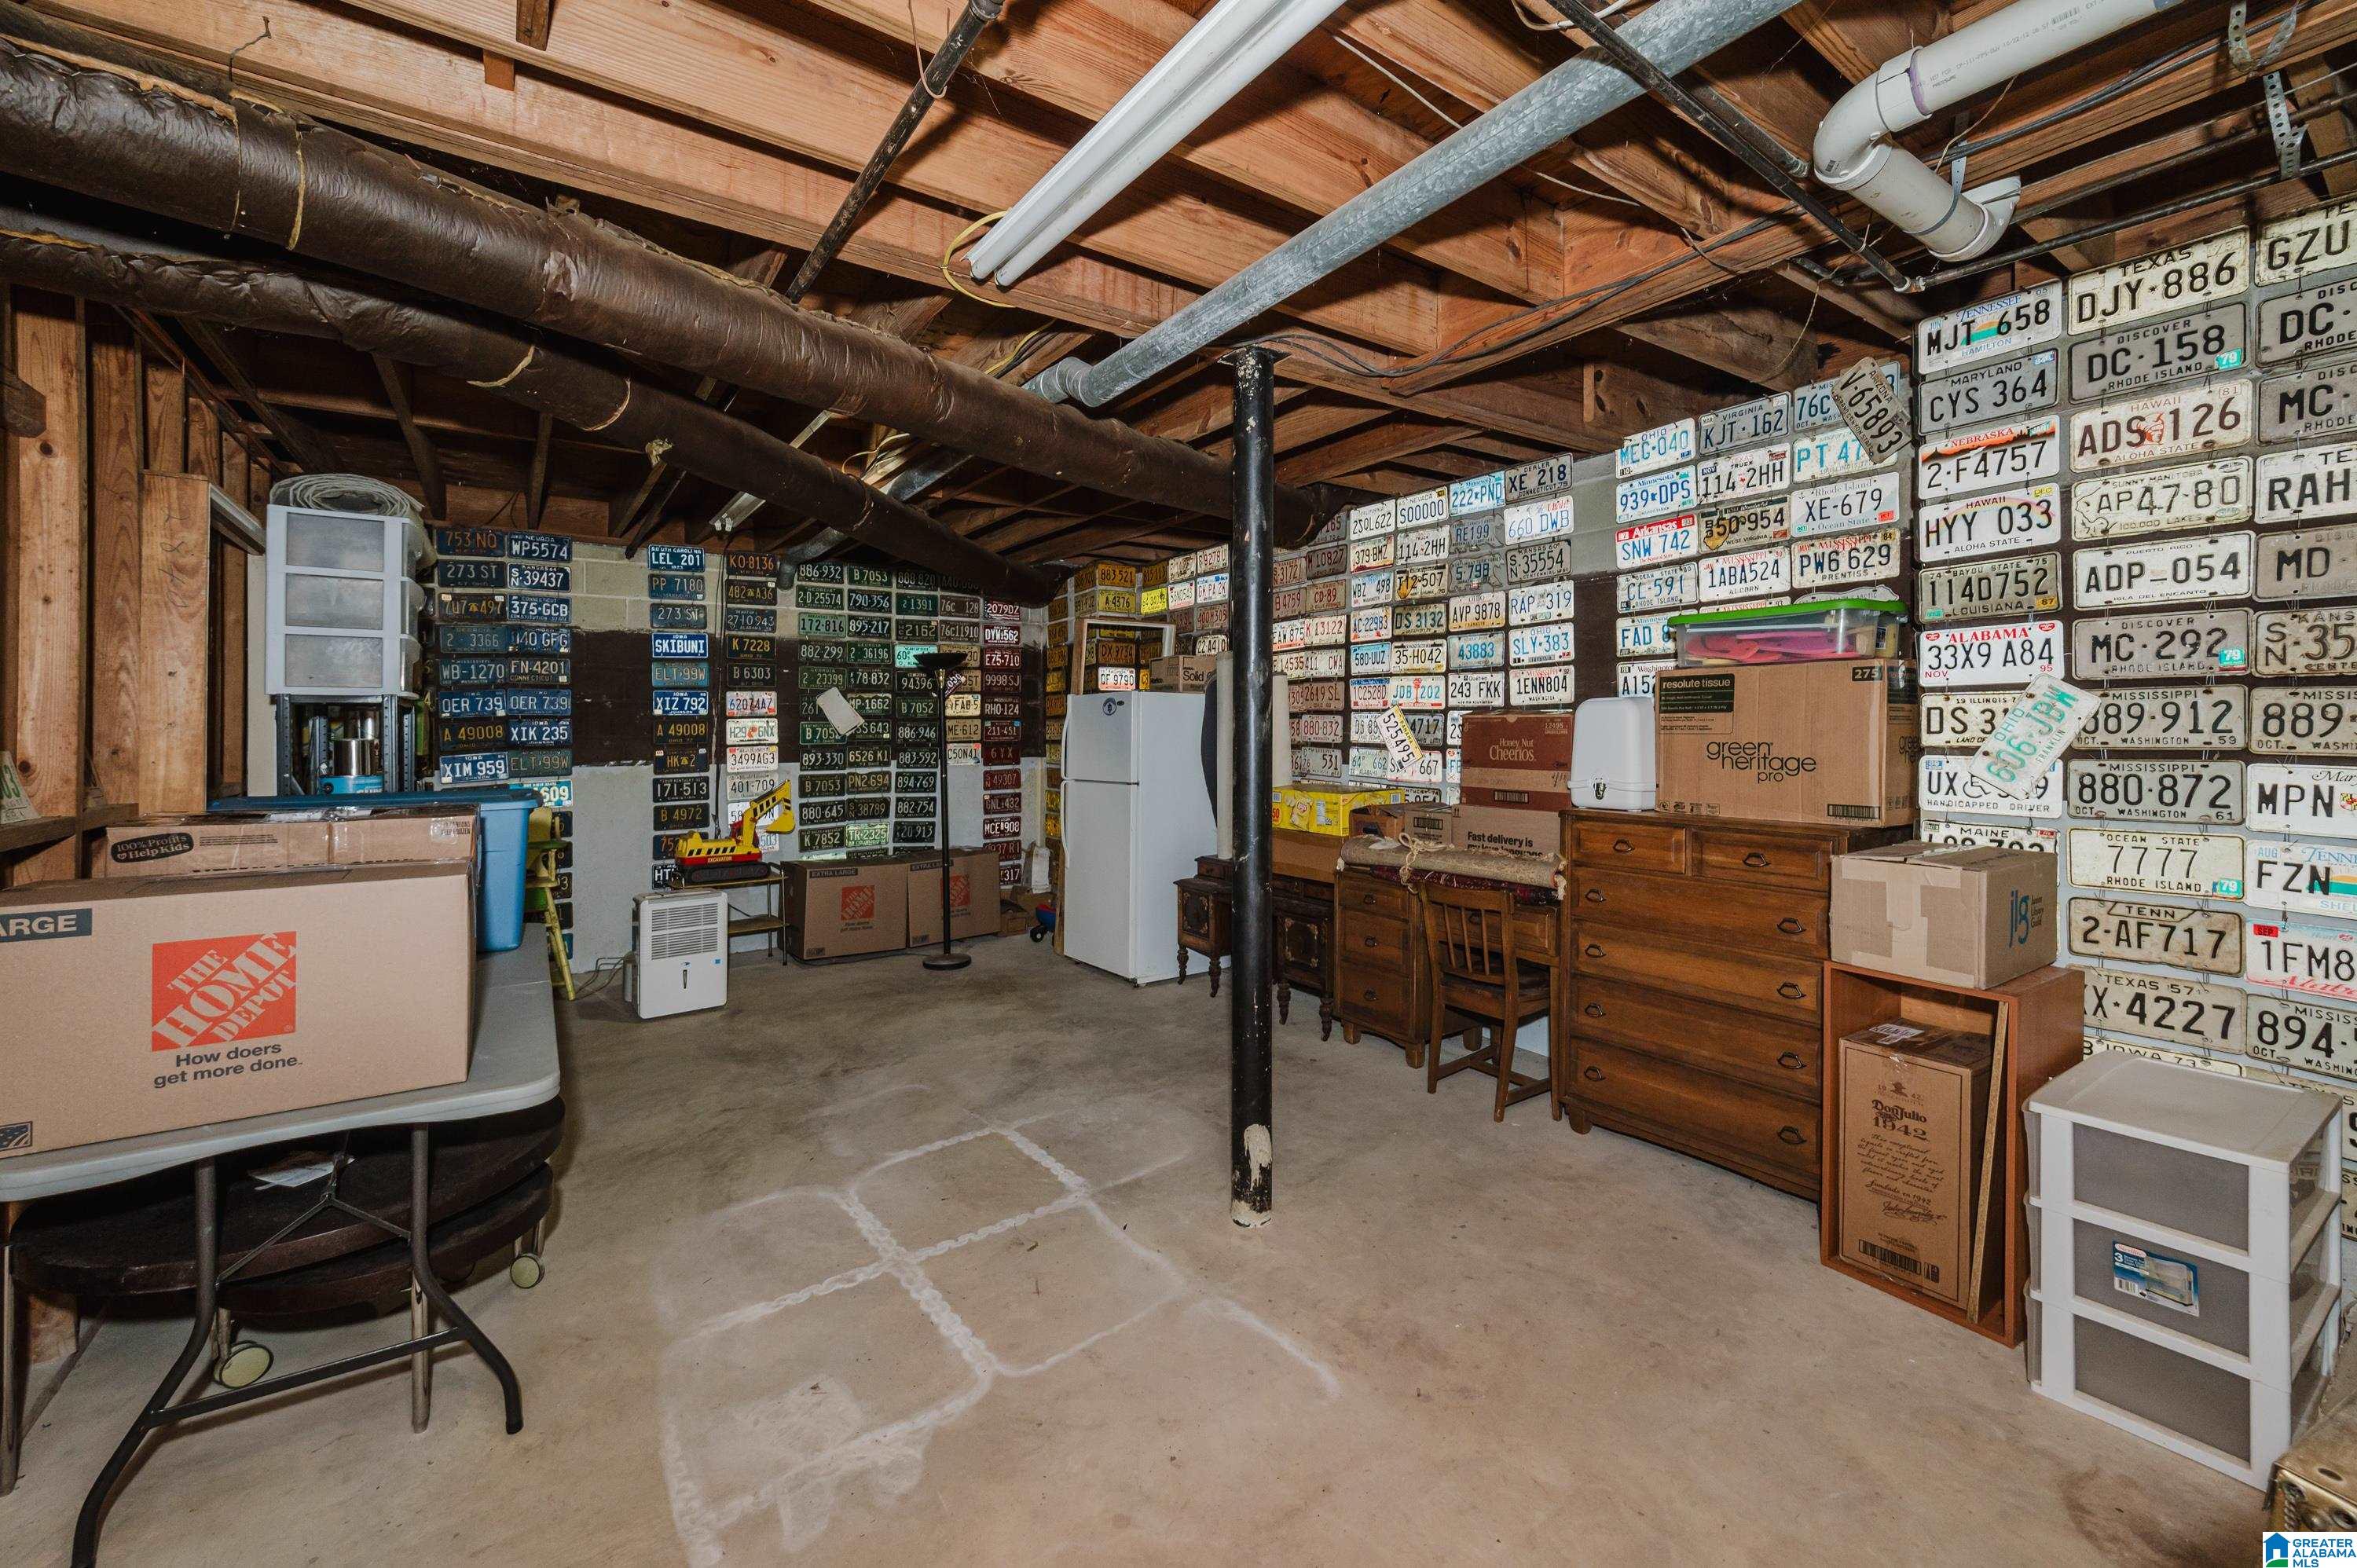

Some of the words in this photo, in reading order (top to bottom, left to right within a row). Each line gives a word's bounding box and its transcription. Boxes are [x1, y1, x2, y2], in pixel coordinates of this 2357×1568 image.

[2267, 220, 2350, 270] GZU
[2121, 247, 2193, 277] TEXAS
[1956, 295, 2022, 322] TENNESSEE
[1927, 321, 1975, 356] MJT
[1997, 299, 2050, 335] 658
[2117, 319, 2190, 344] DISCOVER
[1962, 337, 2011, 357] HAMILTON
[1952, 361, 2022, 387] MARYLAND
[2108, 374, 2150, 390] RHODE
[2156, 362, 2202, 379] ISLAND
[1869, 370, 1893, 404] ARIZONA
[1930, 387, 1979, 422] CYS
[1992, 369, 2047, 407] 364
[2131, 396, 2181, 412] HAWAII
[1723, 405, 1764, 421] VIRGINIA
[1641, 429, 1667, 441] OHIO
[2078, 416, 2146, 457] ADS
[2169, 397, 2240, 441] 126
[1952, 427, 2014, 447] NEBRASKA
[2114, 449, 2154, 463] ALOHA
[2160, 442, 2198, 455] STATE
[1524, 462, 1549, 472] DEALER
[1509, 474, 1527, 493] XE
[1538, 464, 1567, 486] 218
[1637, 474, 1674, 487] Minnesota
[2150, 470, 2203, 482] MANITOBA
[1519, 484, 1556, 497] CONNECTICUT
[1620, 489, 1649, 512] 939
[1659, 480, 1690, 504] DPS
[2268, 468, 2351, 511] RAH
[1967, 496, 2005, 509] HAWAII
[1508, 518, 1532, 538] 660
[1540, 510, 1569, 532] DWB
[1633, 521, 1677, 539] Arkansas
[1926, 511, 1977, 547] HYY
[1998, 499, 2052, 535] 033
[511, 540, 568, 559] WP5574
[1622, 535, 1651, 561] SNW
[1659, 529, 1690, 553] 742
[1818, 535, 1871, 550] MISSISSIPPI
[1955, 543, 1985, 552] ALOHA
[1990, 537, 2020, 547] STATE
[652, 552, 673, 565] LEL
[681, 555, 700, 566] 201
[1800, 551, 1840, 577] PW6
[1848, 544, 1891, 570] 629
[1992, 561, 2022, 571] STATE
[447, 565, 475, 578] 273
[481, 565, 497, 578] ST
[523, 571, 563, 588] 39437
[1708, 559, 1780, 588] 1ABA524
[1822, 570, 1868, 581] PRENTISS
[653, 578, 666, 590] PP
[675, 578, 703, 591] 7180
[1511, 595, 1534, 616] RAP
[1546, 591, 1571, 609] 319
[1953, 602, 2024, 616] LOUISIANA
[658, 607, 681, 620] 273
[1453, 605, 1471, 624] AVP
[1475, 602, 1500, 621] 9878
[2121, 617, 2194, 629] DISCOVER
[1622, 626, 1651, 647] FAD
[1948, 628, 2029, 643] ALABAMA
[1928, 642, 1991, 669] 33X9
[2003, 638, 2053, 666] A84
[1113, 674, 1134, 686] 9790
[1182, 671, 1204, 681] Solid
[1663, 679, 1700, 690] resolute
[1702, 679, 1731, 687] tissue
[1450, 682, 1471, 698] 243
[1479, 681, 1501, 698] FKK
[2112, 691, 2198, 700] MISSISSIPPI
[477, 698, 503, 711] 739
[656, 698, 679, 710] XIZ
[684, 697, 706, 710] 792
[1994, 707, 2025, 742] OHIO
[511, 727, 537, 741] XIK
[542, 727, 568, 740] 235
[1500, 738, 1520, 747] Honey
[1706, 742, 1771, 760] green
[2036, 729, 2066, 764] FRANKLIN
[445, 764, 472, 778] XIM
[477, 760, 504, 775] 959
[1722, 753, 1816, 776] heritage
[2110, 764, 2194, 772] MISSISSIPPI
[1758, 771, 1784, 783] pro
[1927, 799, 1999, 810] HANDICAPPED
[2010, 803, 2050, 812] DRIVER
[2258, 783, 2333, 817] MPN
[2117, 808, 2187, 818] WASHINGTON
[1468, 832, 1485, 841] Fast
[1487, 833, 1523, 847] delivery
[1525, 837, 1533, 847] is
[1960, 827, 2009, 837] MAINE
[2107, 833, 2146, 843] OCEAN
[2162, 837, 2200, 846] STATE
[118, 841, 147, 852] 100%
[150, 835, 188, 848] Profits
[129, 848, 157, 859] Help
[160, 844, 190, 854] Kids
[2107, 844, 2198, 878] 7777
[2106, 876, 2146, 888] RHODE
[2156, 881, 2201, 892] ISLAND
[2257, 859, 2330, 896] FZN
[2125, 906, 2176, 918] TENN
[167, 949, 229, 996] THE
[153, 933, 297, 1048] HOME
[2105, 975, 2160, 991] TEXAS
[211, 969, 297, 1043] DEPOT
[176, 1052, 221, 1068] How
[226, 1042, 282, 1060] doers
[153, 1070, 187, 1089] get
[192, 1062, 244, 1081] more
